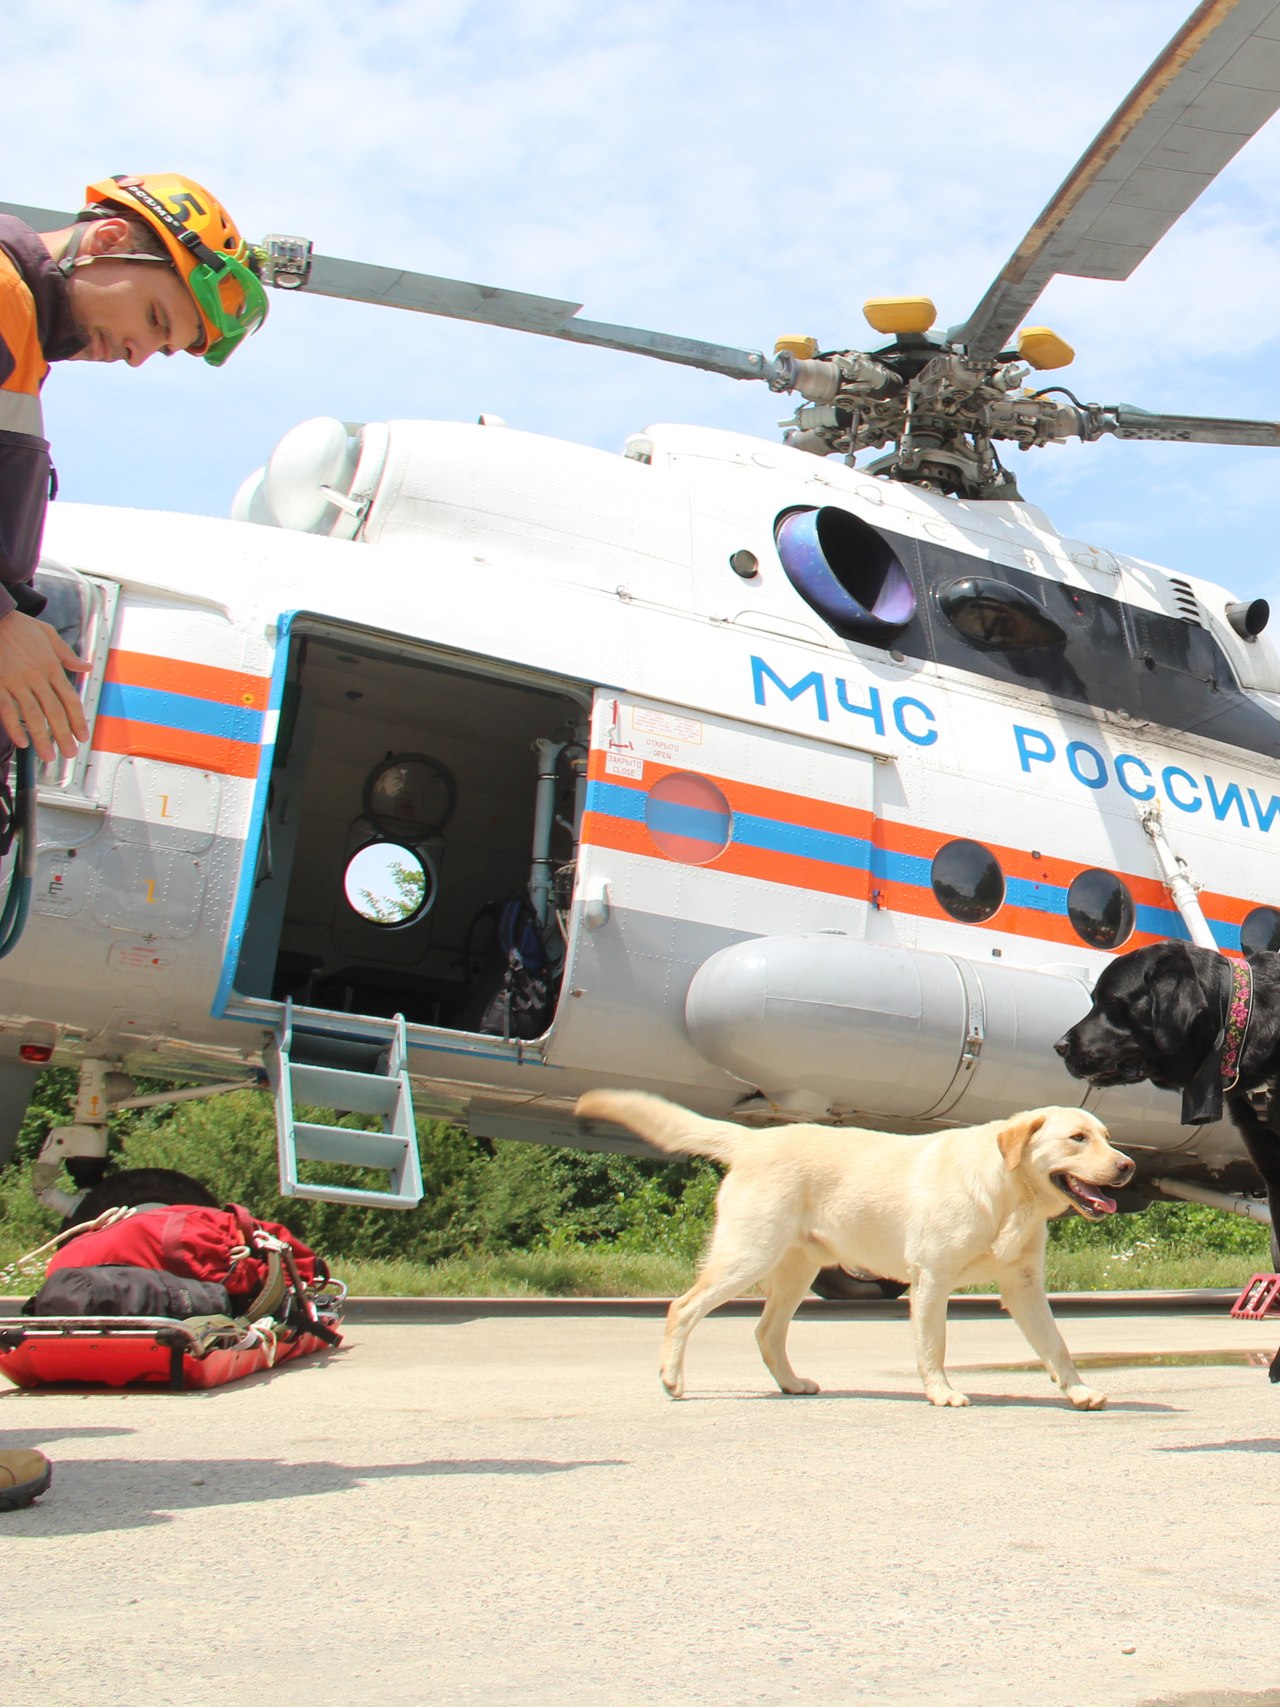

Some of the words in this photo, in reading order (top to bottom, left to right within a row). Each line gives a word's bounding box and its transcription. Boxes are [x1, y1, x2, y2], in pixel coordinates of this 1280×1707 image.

[168, 193, 207, 222] 5
[750, 655, 938, 746] МЧС
[646, 738, 679, 752] ОТКРЫТО
[608, 754, 641, 769] ЗАКРЫТО
[653, 749, 672, 760] OPEN
[612, 765, 635, 777] CLOSE
